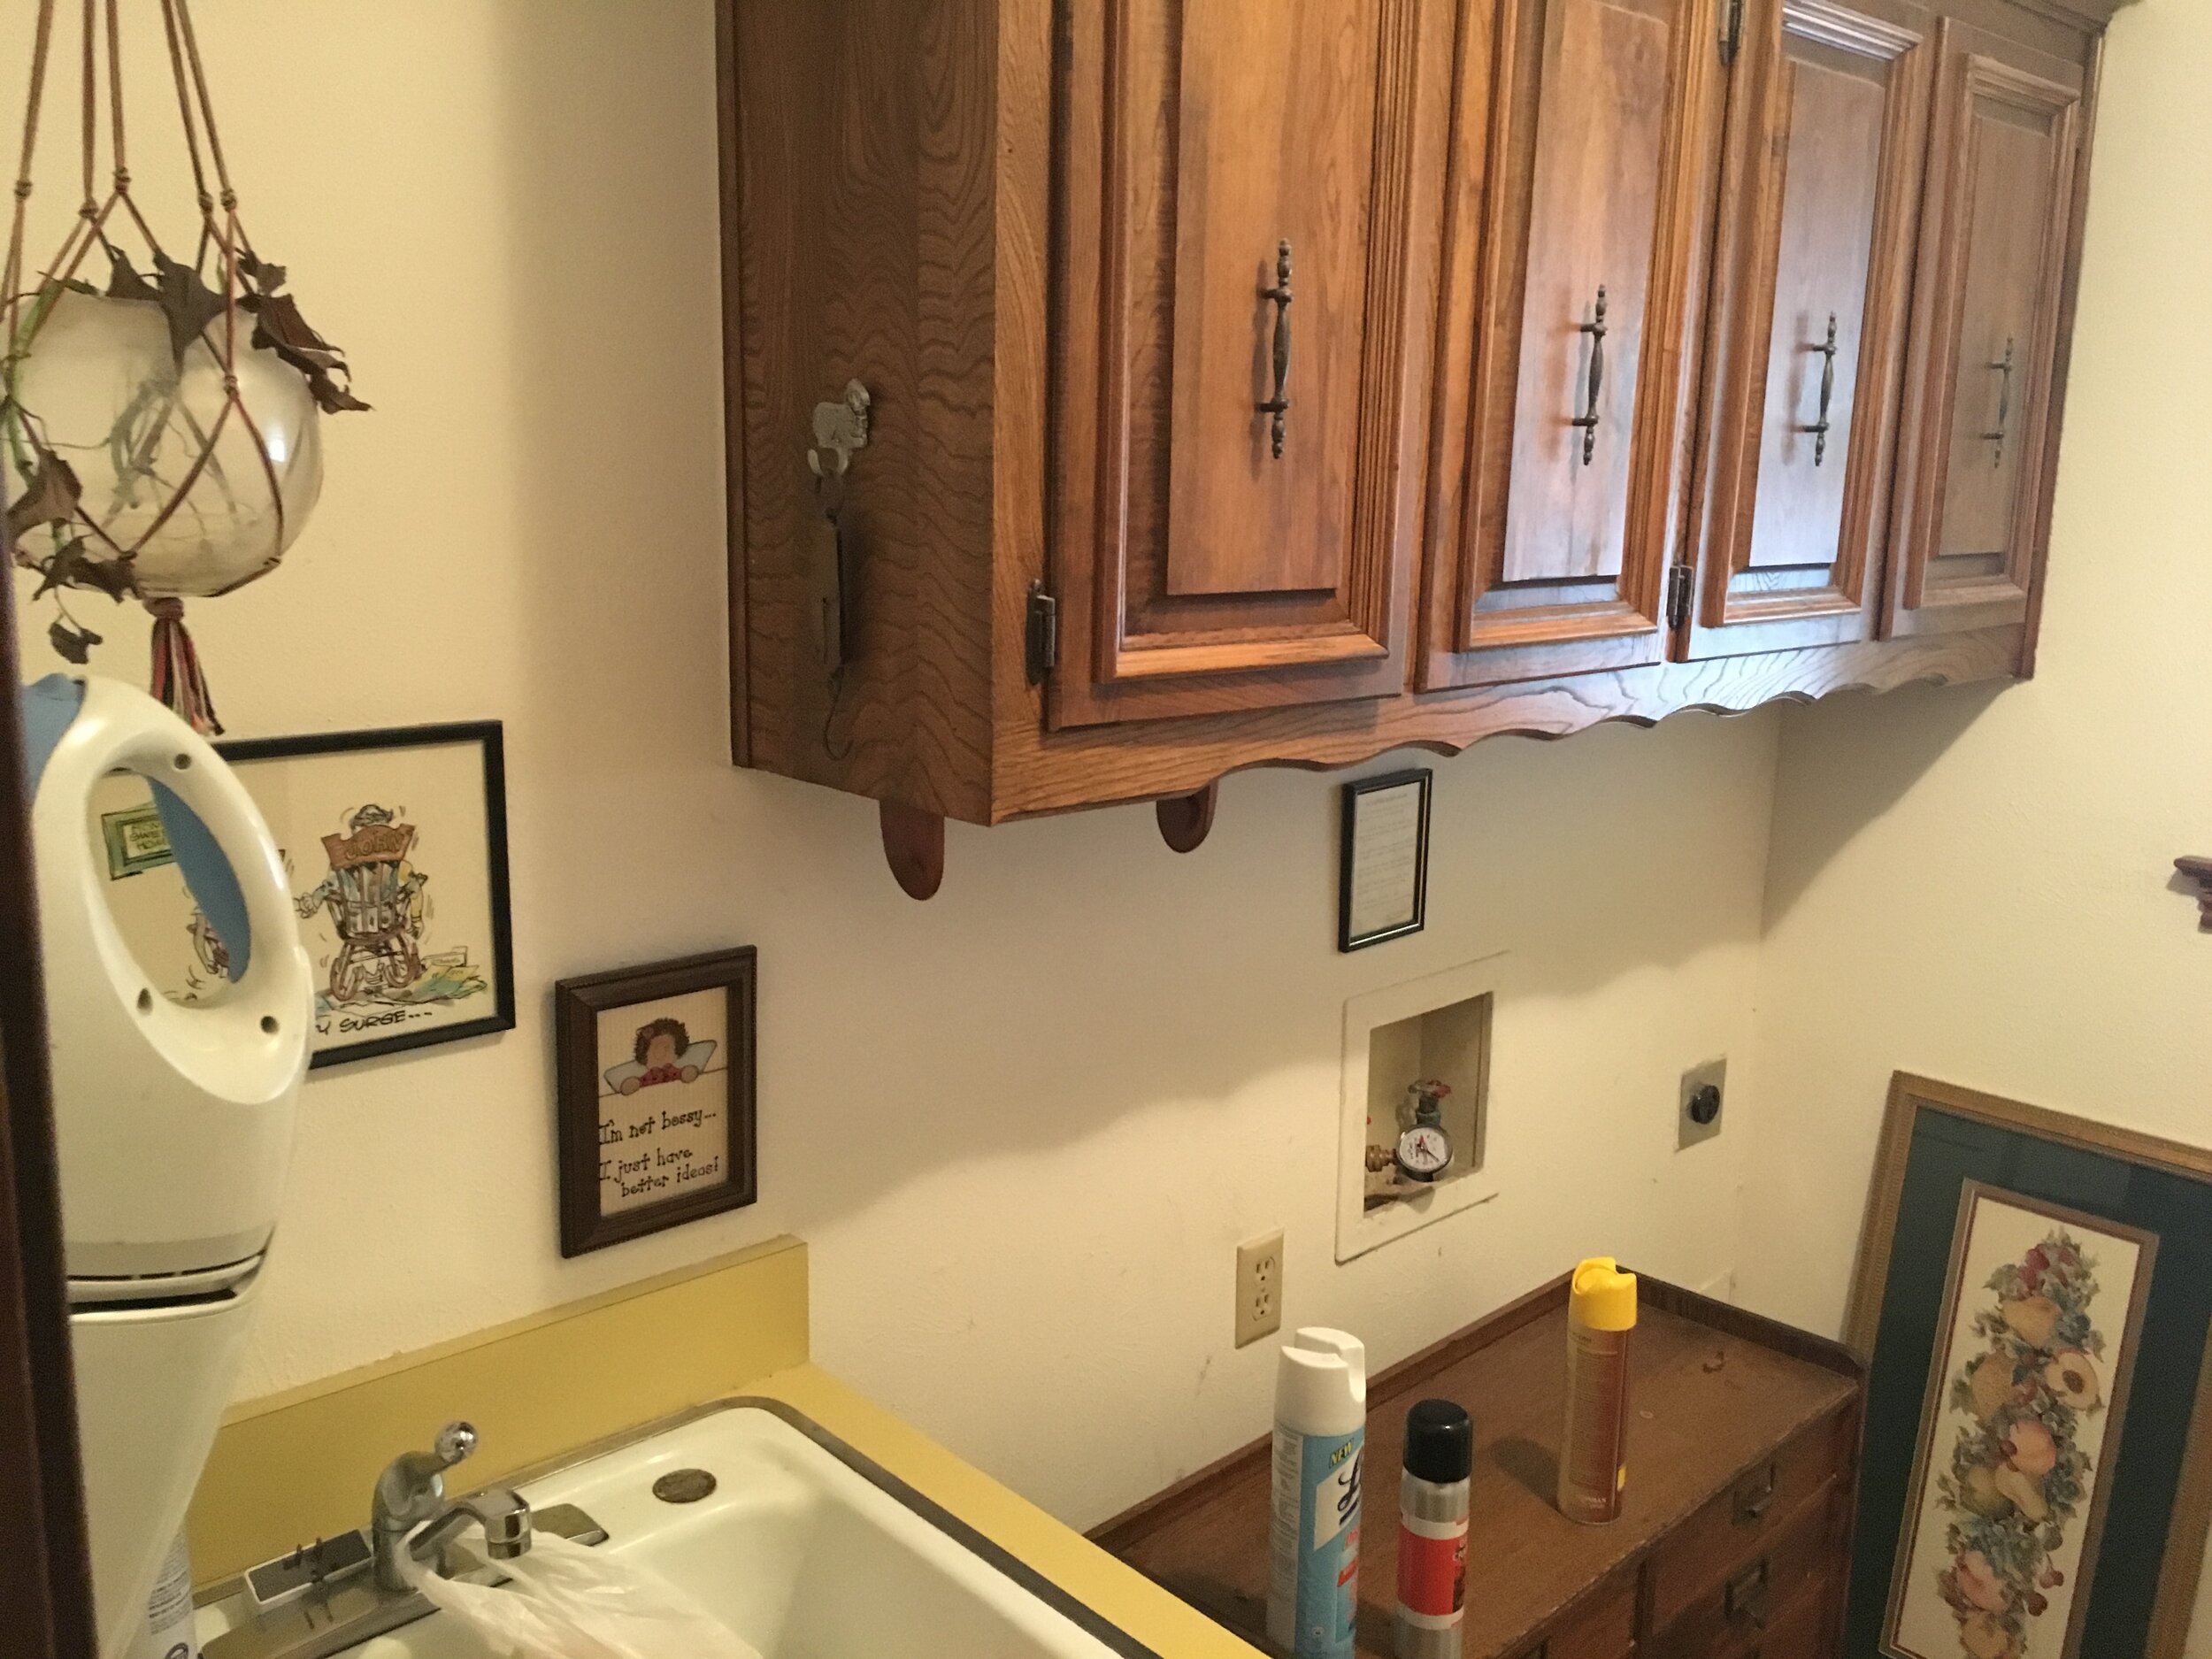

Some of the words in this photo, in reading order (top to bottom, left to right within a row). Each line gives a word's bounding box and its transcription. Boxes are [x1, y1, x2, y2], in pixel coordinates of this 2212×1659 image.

[345, 833, 404, 860] JOHN
[599, 1118, 623, 1145] I'm
[628, 1116, 656, 1139] not
[661, 1110, 716, 1130] bossy...
[599, 1159, 612, 1181] I
[613, 1152, 650, 1184] just
[657, 1147, 693, 1167] have
[621, 1175, 670, 1198] better
[676, 1155, 719, 1183] ideas!
[1330, 1440, 1353, 1467] NEW
